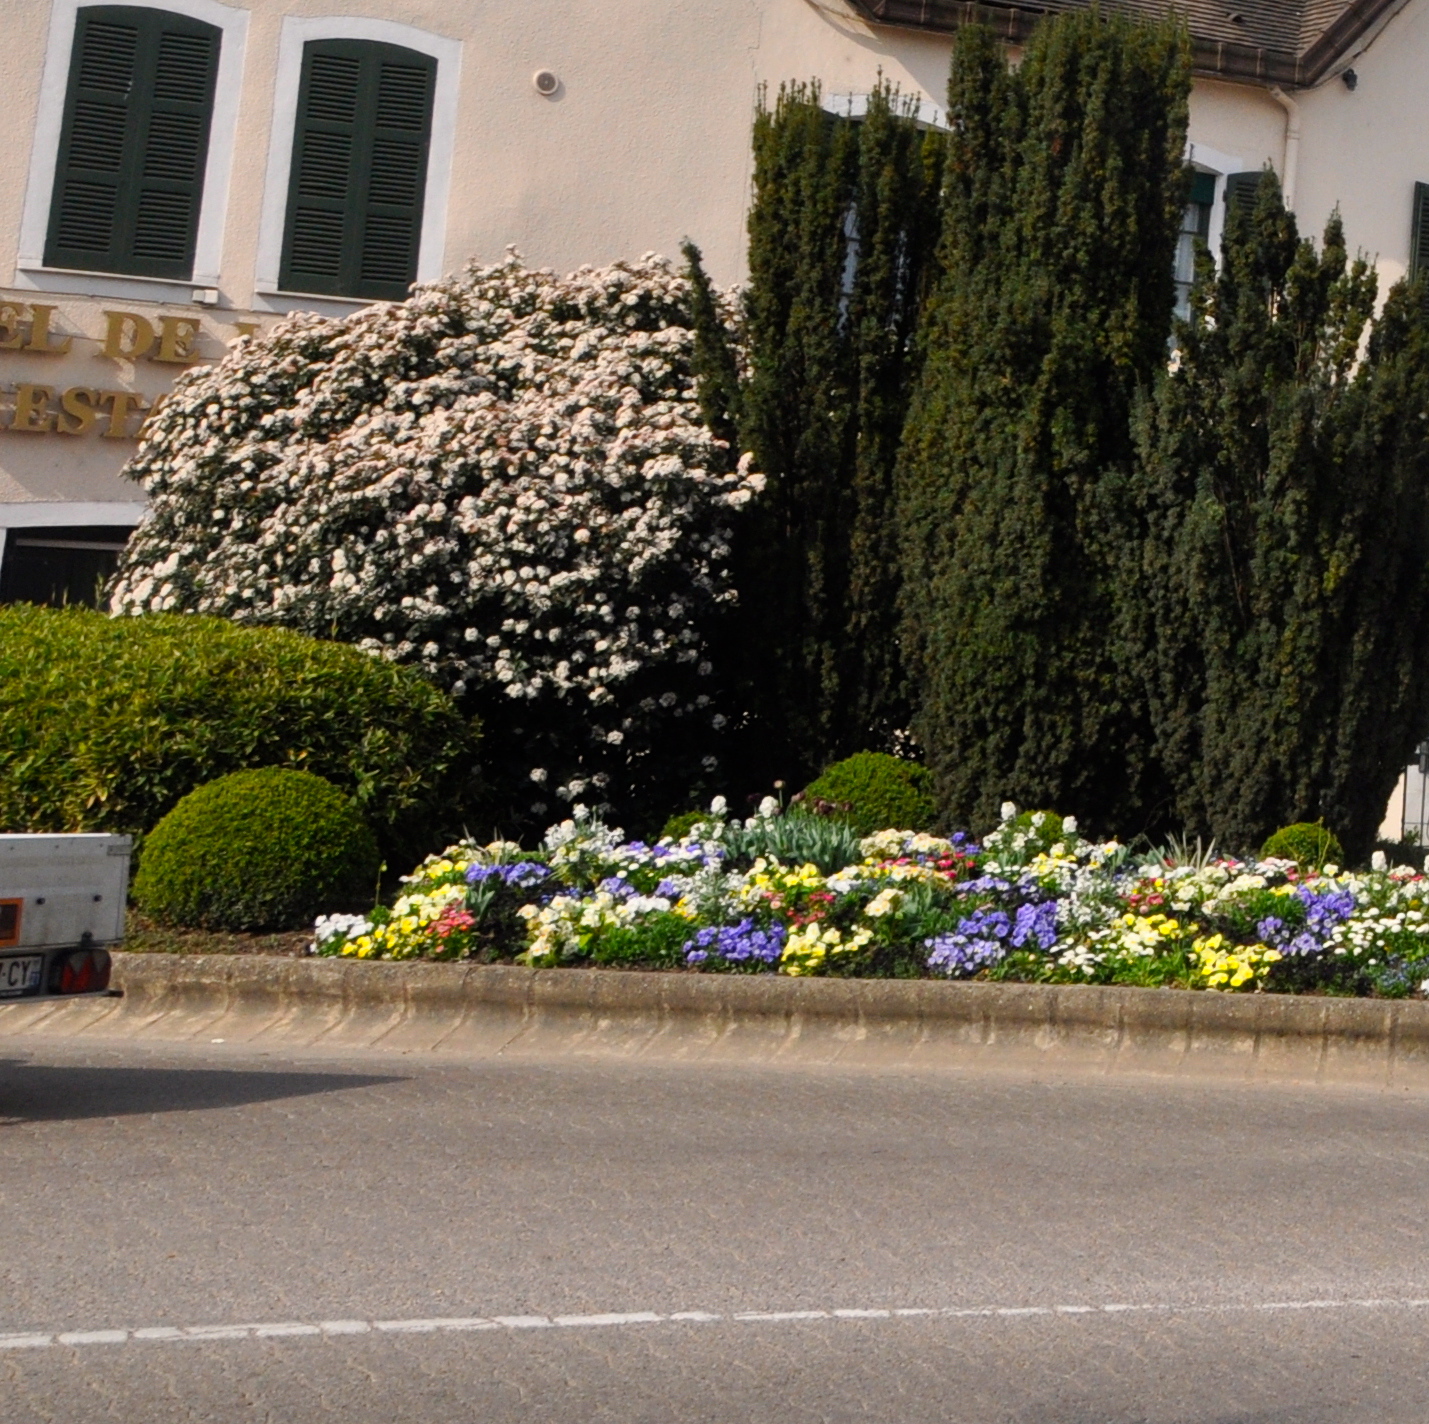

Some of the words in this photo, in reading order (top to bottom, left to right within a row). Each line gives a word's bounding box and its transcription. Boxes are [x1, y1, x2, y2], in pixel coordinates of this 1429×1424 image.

[96, 310, 201, 363] DE
[9, 384, 166, 439] EST
[0, 960, 31, 987] -CY
